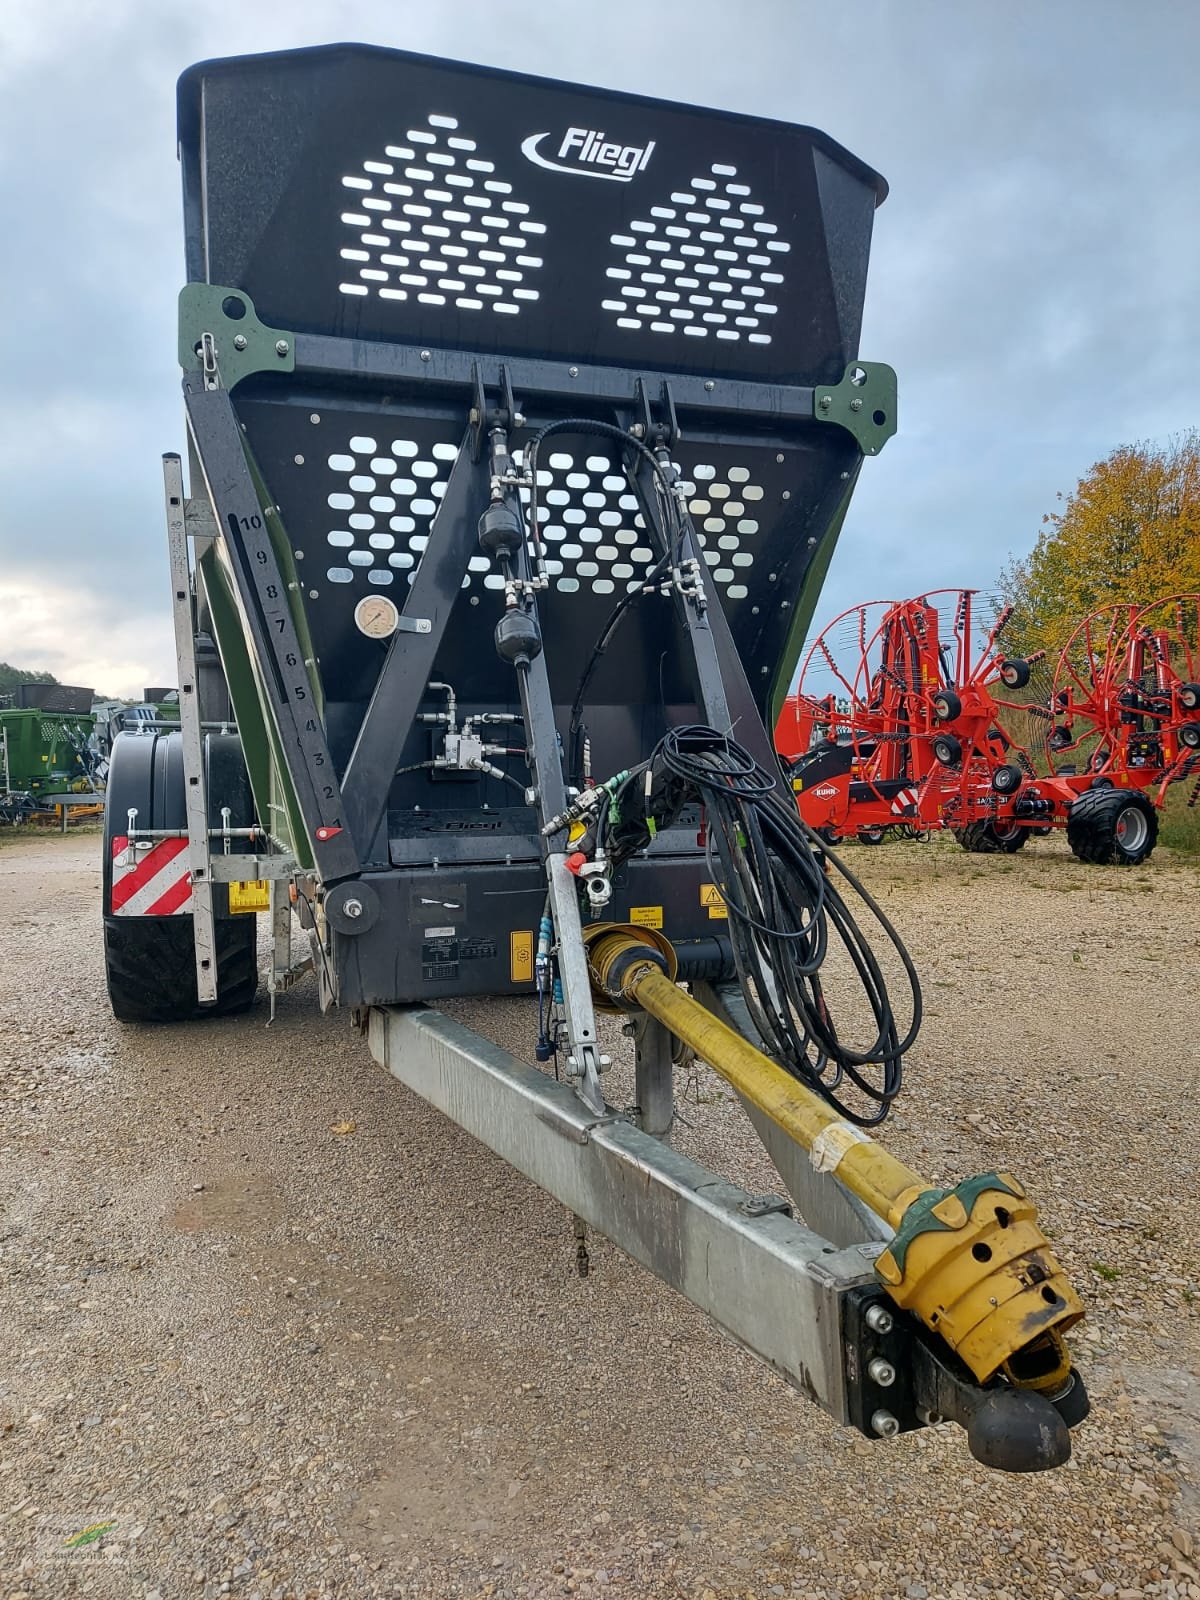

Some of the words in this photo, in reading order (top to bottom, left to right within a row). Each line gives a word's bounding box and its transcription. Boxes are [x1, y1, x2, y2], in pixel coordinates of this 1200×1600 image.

[557, 127, 656, 177] Fliegl
[241, 515, 262, 531] 10
[256, 550, 267, 564] 9
[266, 585, 278, 599] 8
[275, 619, 286, 633] 7
[286, 652, 297, 667] 6
[294, 686, 306, 700] 5
[306, 719, 317, 732] 4
[313, 752, 325, 766] 3
[322, 786, 335, 799] 2
[816, 788, 836, 797] KUHN
